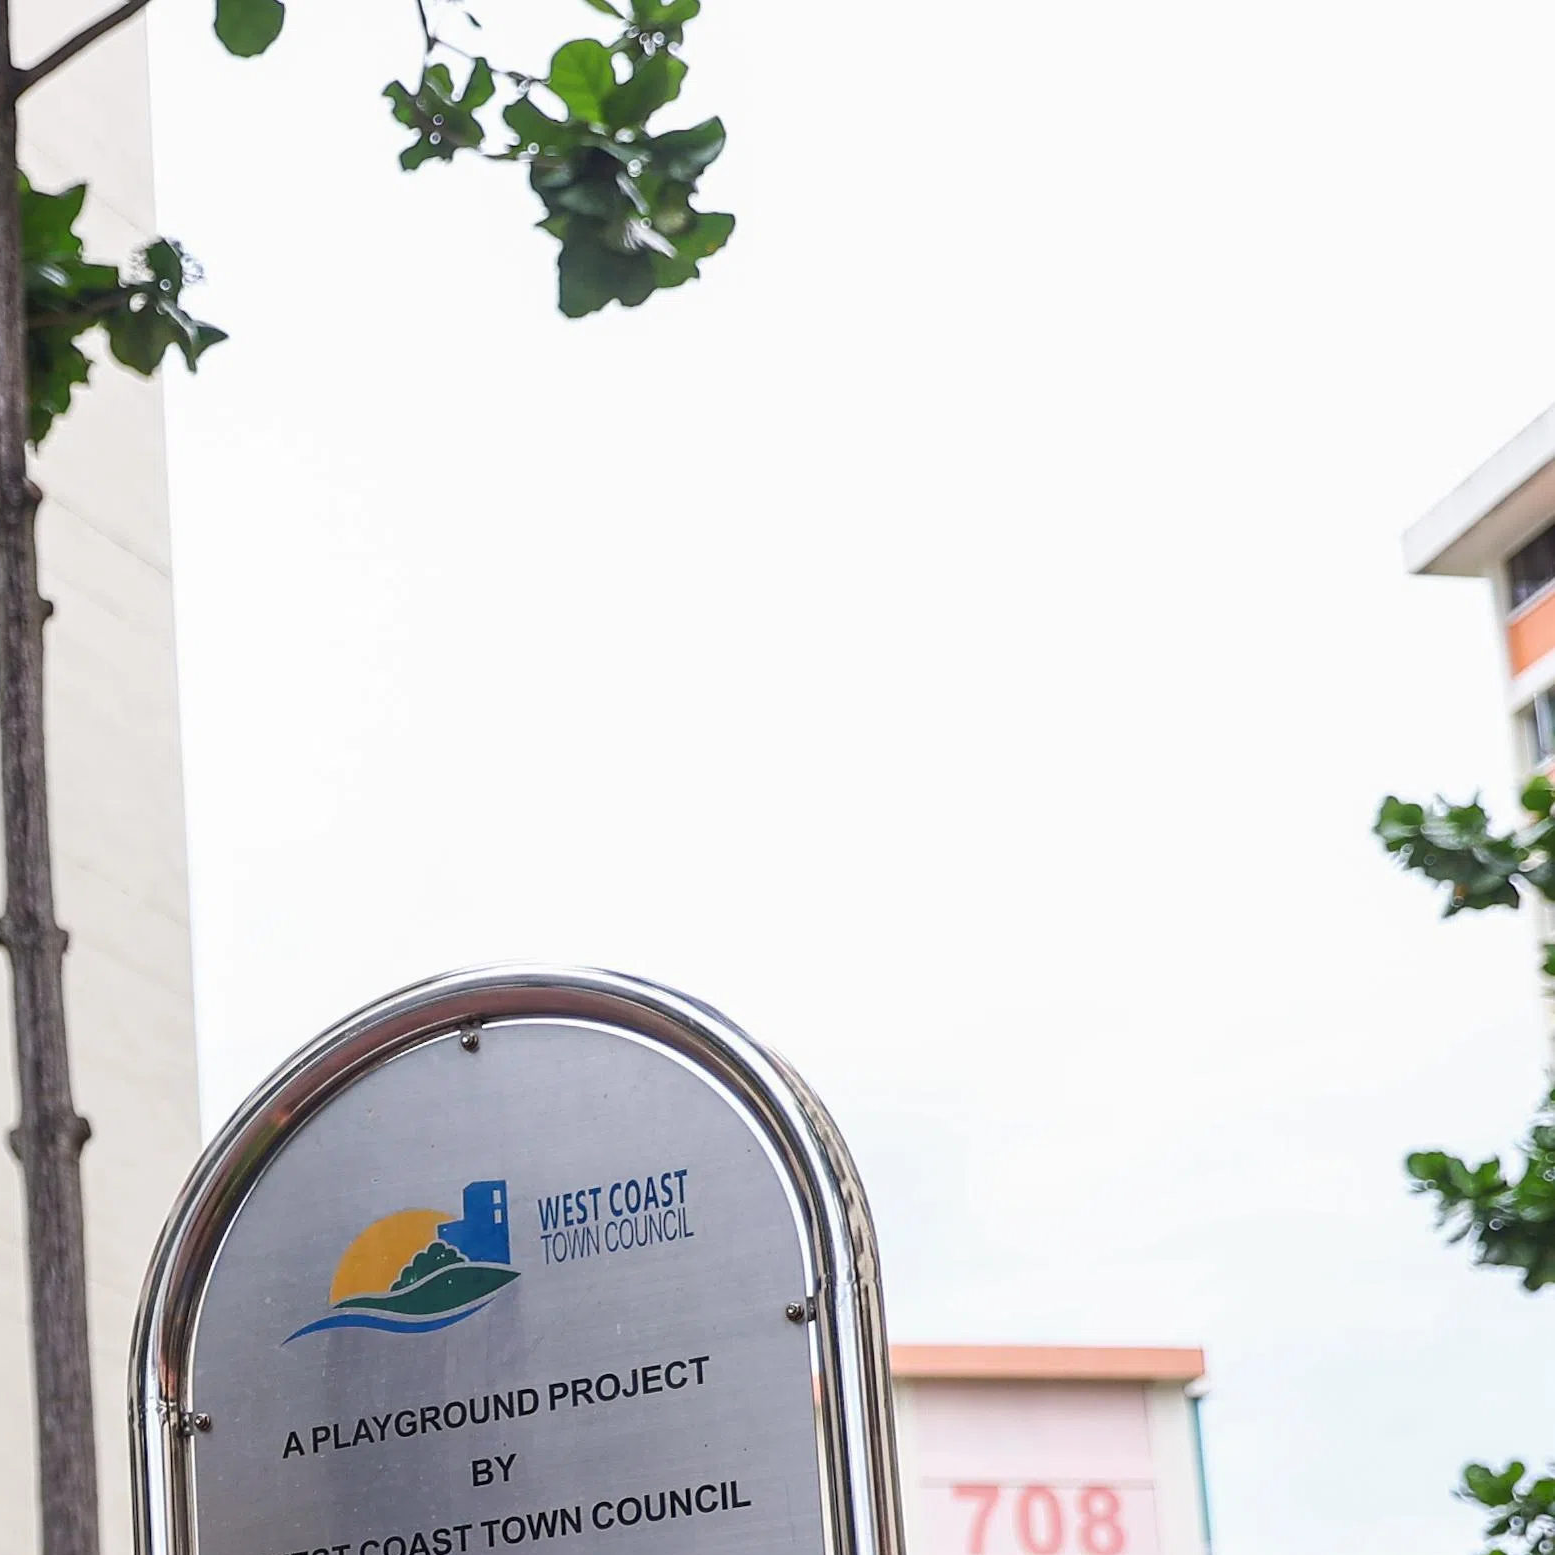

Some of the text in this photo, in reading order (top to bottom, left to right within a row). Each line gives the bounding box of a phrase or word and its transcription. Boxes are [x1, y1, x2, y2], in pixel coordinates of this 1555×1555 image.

[536, 1168, 688, 1232] WEST COAST
[540, 1207, 695, 1265] TOWN COUNCIL
[282, 1355, 710, 1460] A PLAYGROUND PROJECT
[471, 1452, 518, 1488] BY
[480, 1505, 582, 1548] TOWN
[591, 1480, 752, 1530] COUNCIL
